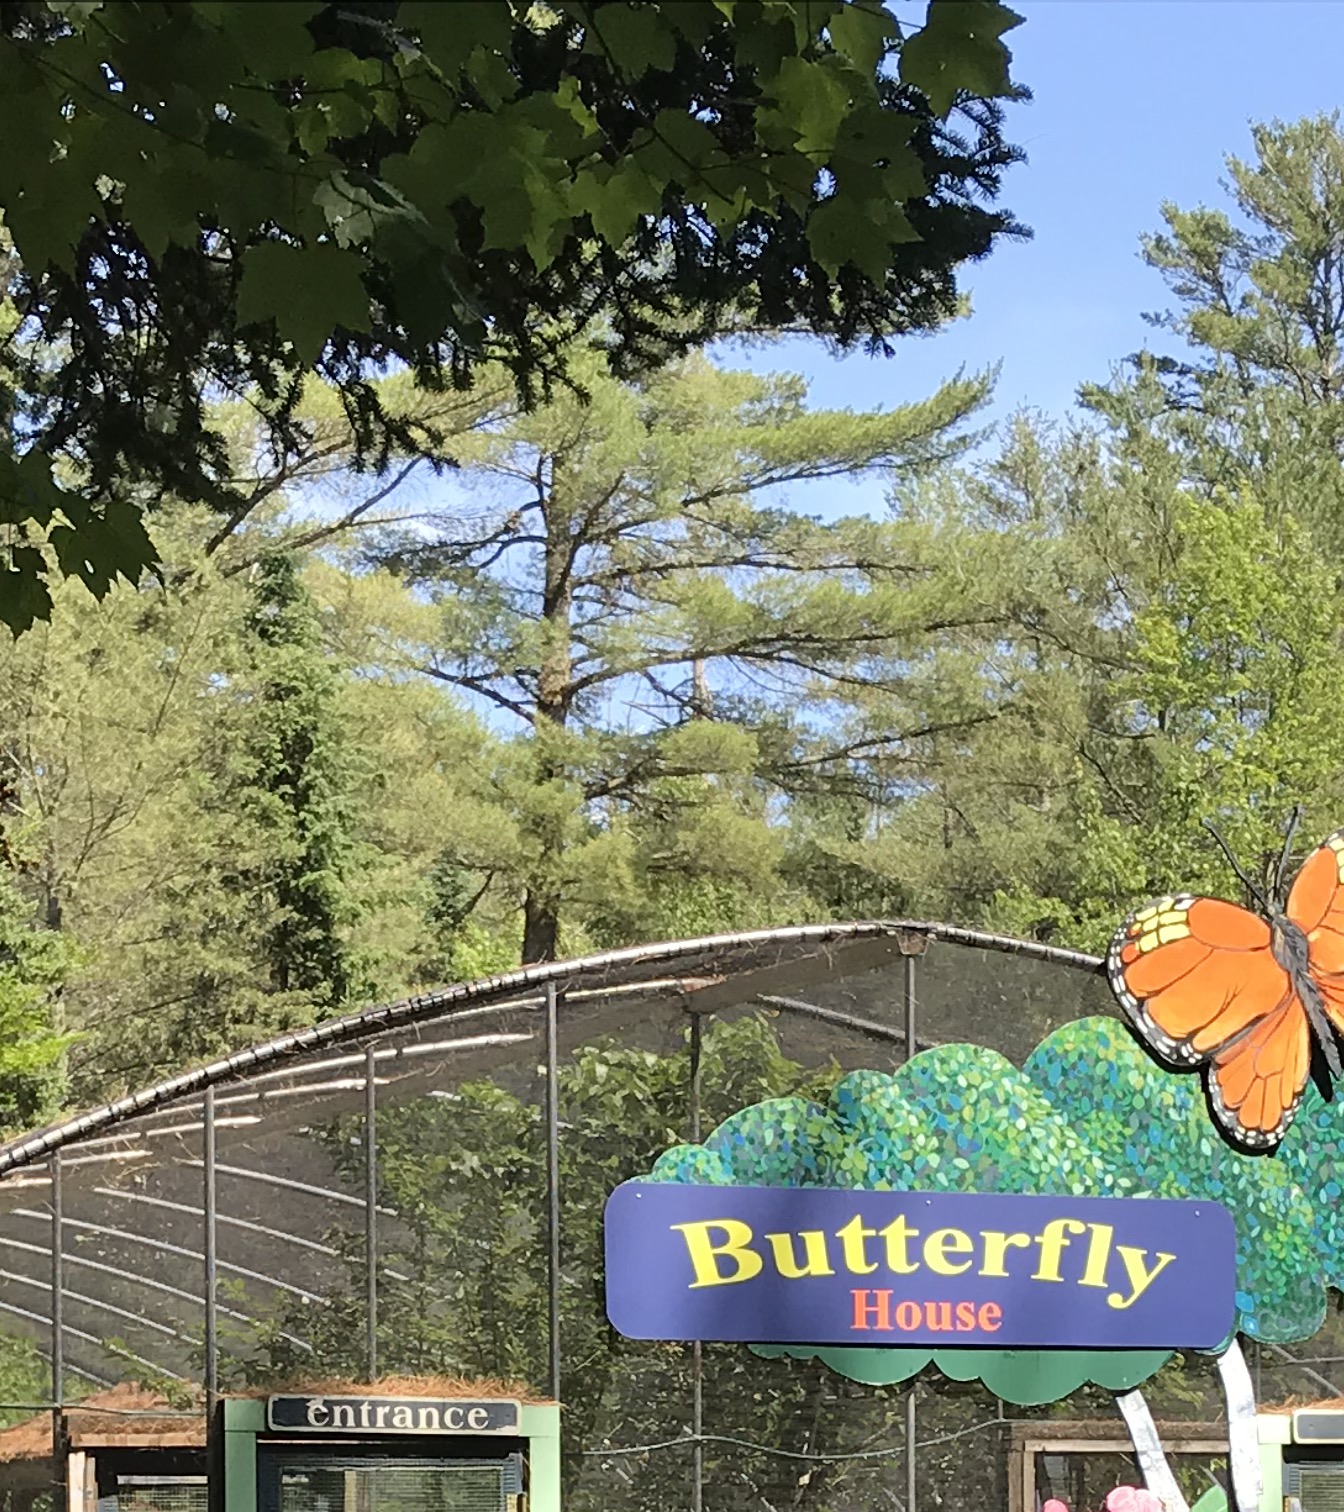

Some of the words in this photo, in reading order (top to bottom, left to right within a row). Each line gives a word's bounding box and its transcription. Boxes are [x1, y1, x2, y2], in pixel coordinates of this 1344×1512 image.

[670, 1213, 1177, 1310] Butterfly
[849, 1288, 1003, 1333] House
[306, 1399, 490, 1430] entrance
